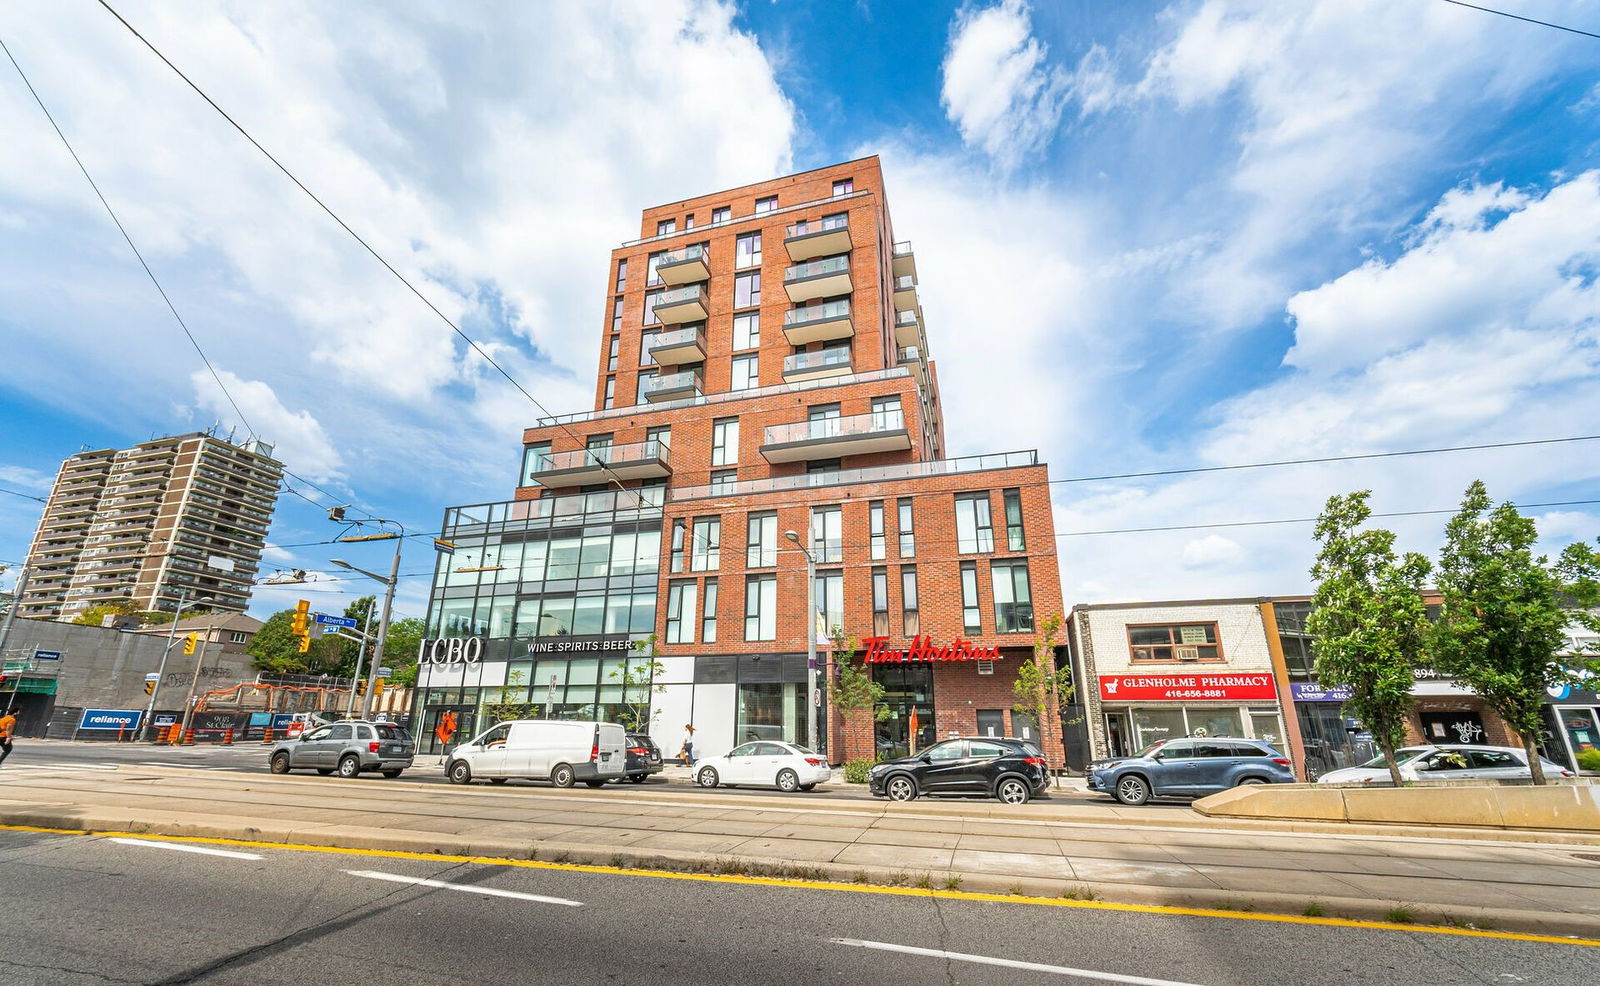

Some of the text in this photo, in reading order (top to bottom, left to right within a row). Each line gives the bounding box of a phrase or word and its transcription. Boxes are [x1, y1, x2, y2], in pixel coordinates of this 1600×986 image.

[322, 616, 345, 625] Alberta
[417, 636, 481, 664] LCBO
[527, 640, 632, 653] WINE SPIRITS BEER
[862, 634, 1000, 664] Tim Hortons
[1414, 668, 1437, 678] 894
[1123, 676, 1268, 688] GLENHOLME PHARMACY
[1300, 684, 1321, 692] FOR
[1165, 690, 1226, 698] 416-656-8881
[90, 715, 132, 724] reliance
